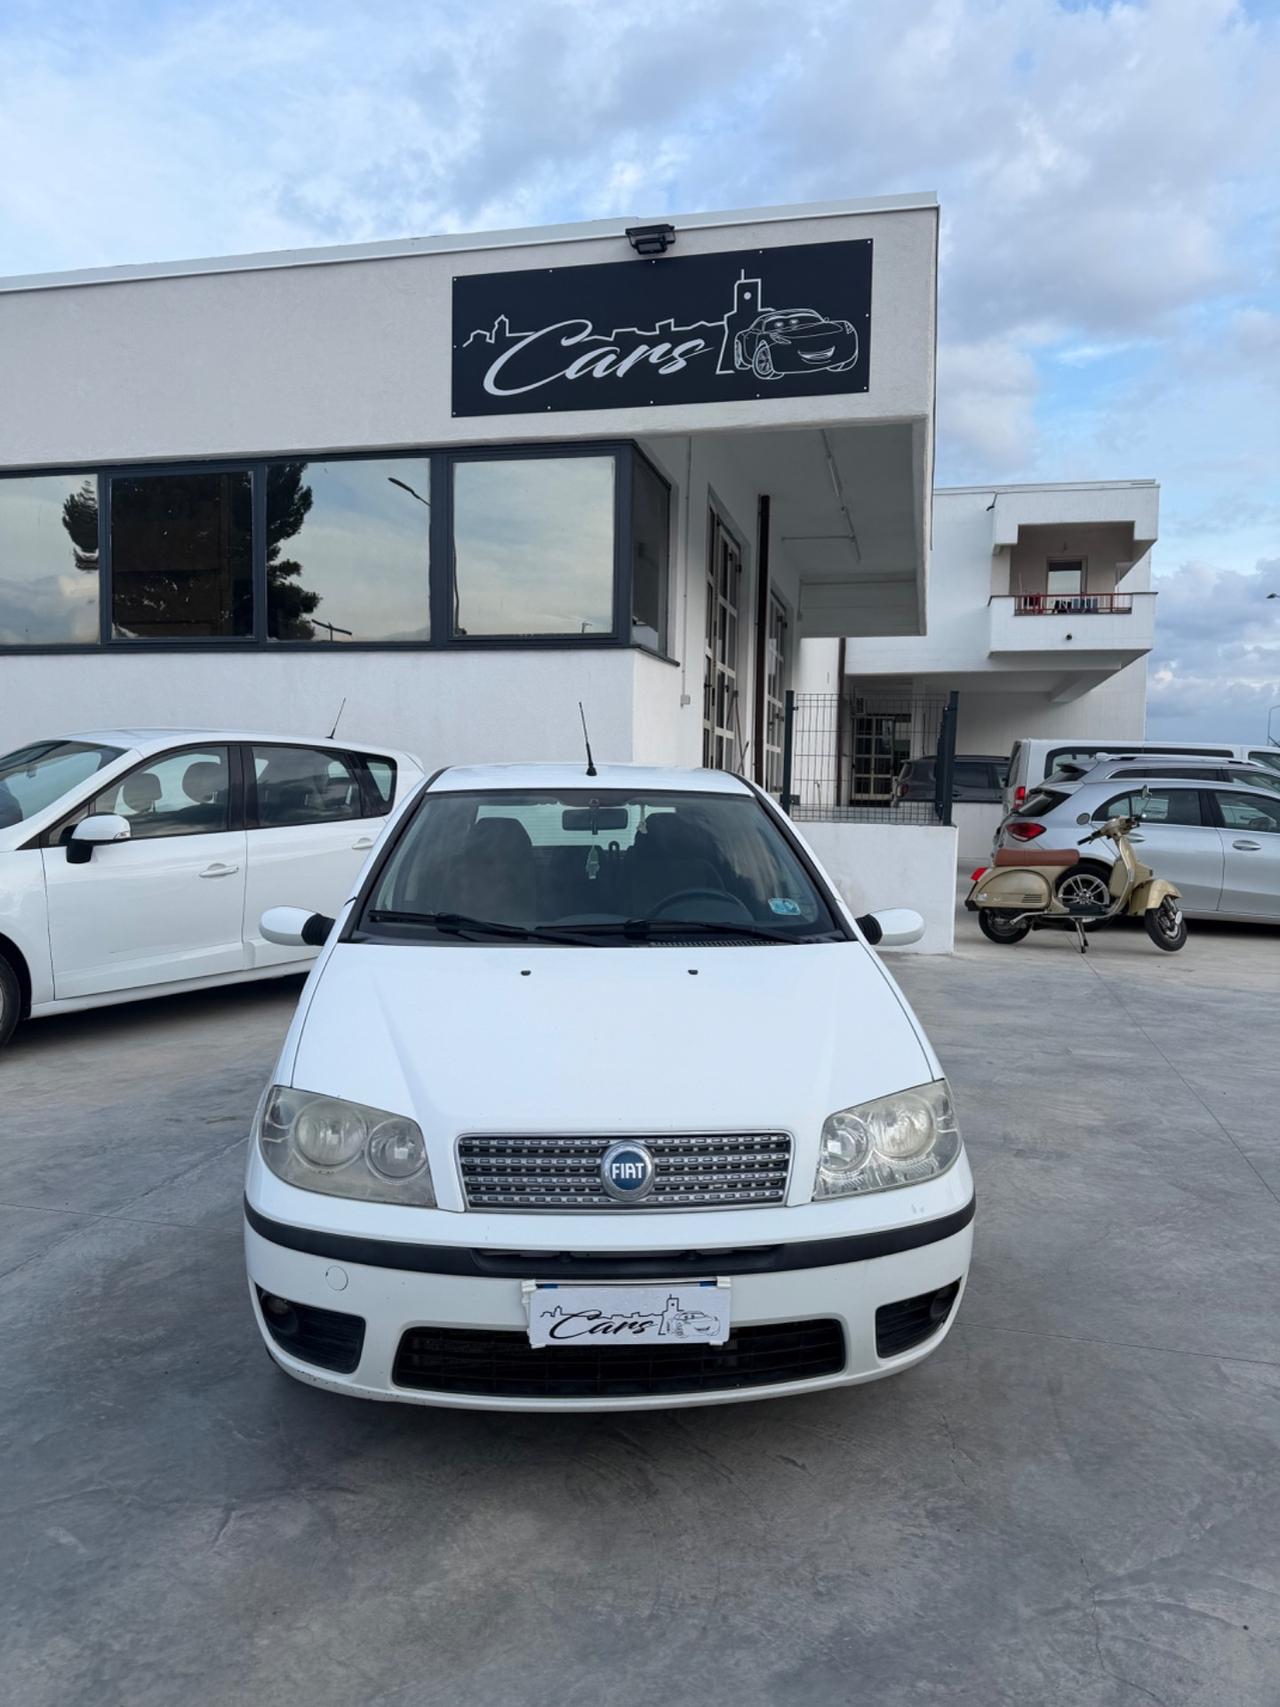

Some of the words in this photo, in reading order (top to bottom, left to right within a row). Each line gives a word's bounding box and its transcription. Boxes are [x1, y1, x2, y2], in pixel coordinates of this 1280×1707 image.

[483, 319, 714, 396] Cars
[611, 1163, 645, 1179] FIAT
[549, 1309, 656, 1340] Cars
